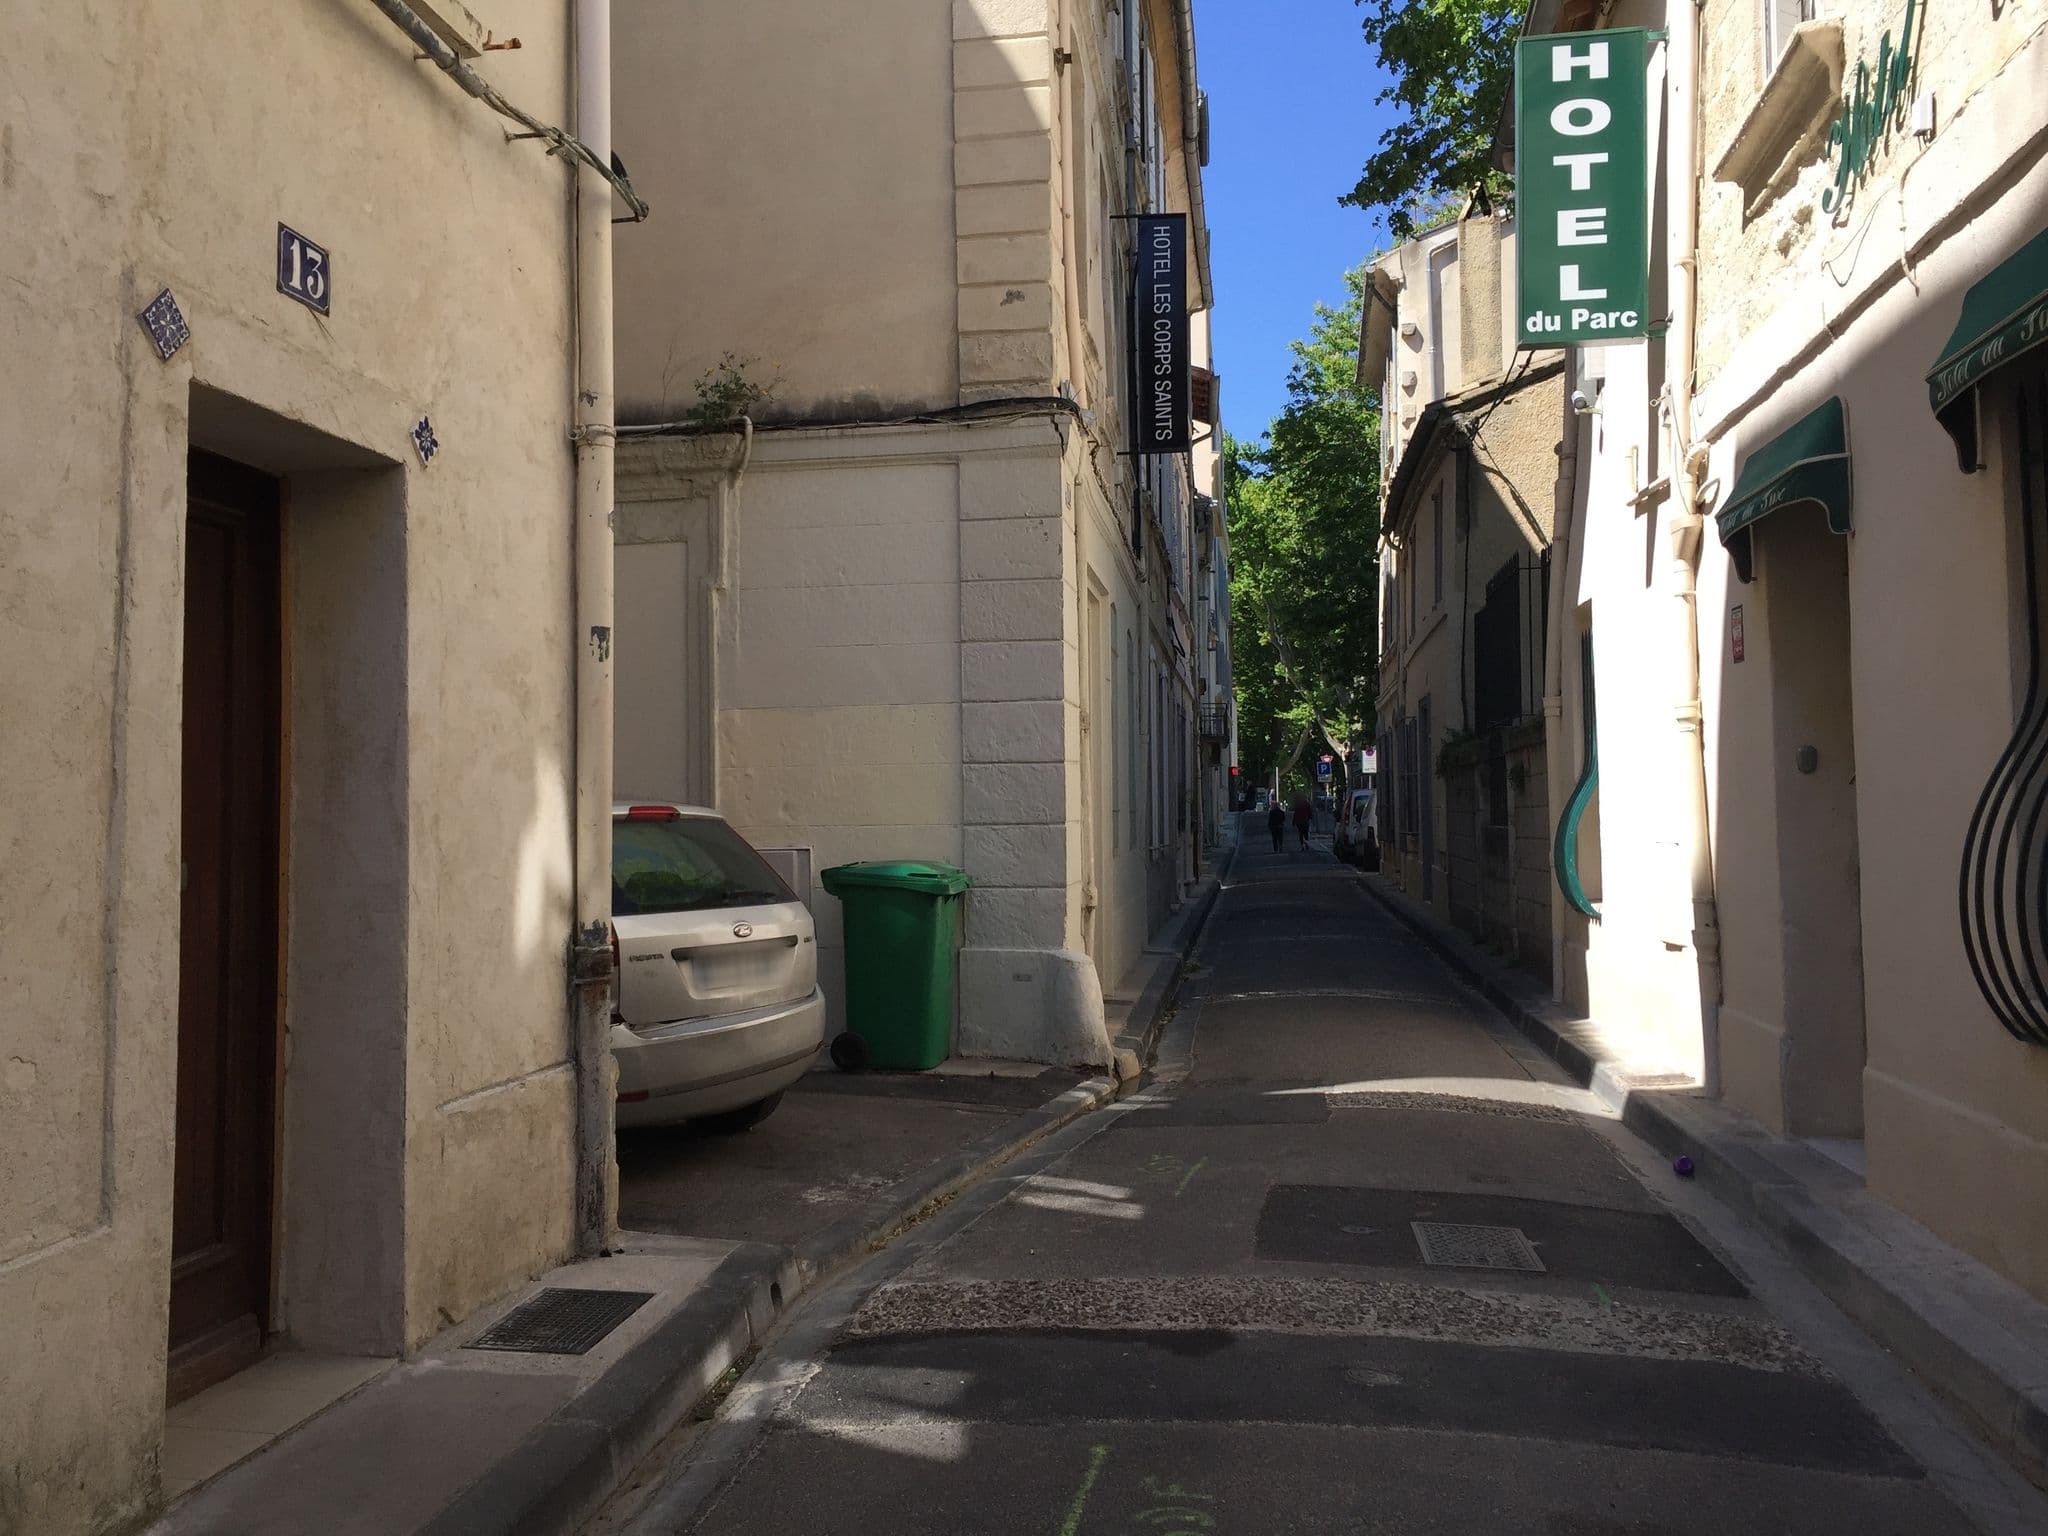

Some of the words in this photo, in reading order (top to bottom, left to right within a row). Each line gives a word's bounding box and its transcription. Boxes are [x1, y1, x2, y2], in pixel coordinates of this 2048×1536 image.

[1550, 42, 1611, 301] HOTEL
[289, 239, 325, 299] 13
[1153, 226, 1170, 279] HOTEL
[1153, 284, 1171, 314] LES
[1526, 310, 1561, 333] du
[1571, 308, 1639, 331] Parc
[1154, 319, 1172, 375] CORPS
[1154, 380, 1173, 441] SAINTS
